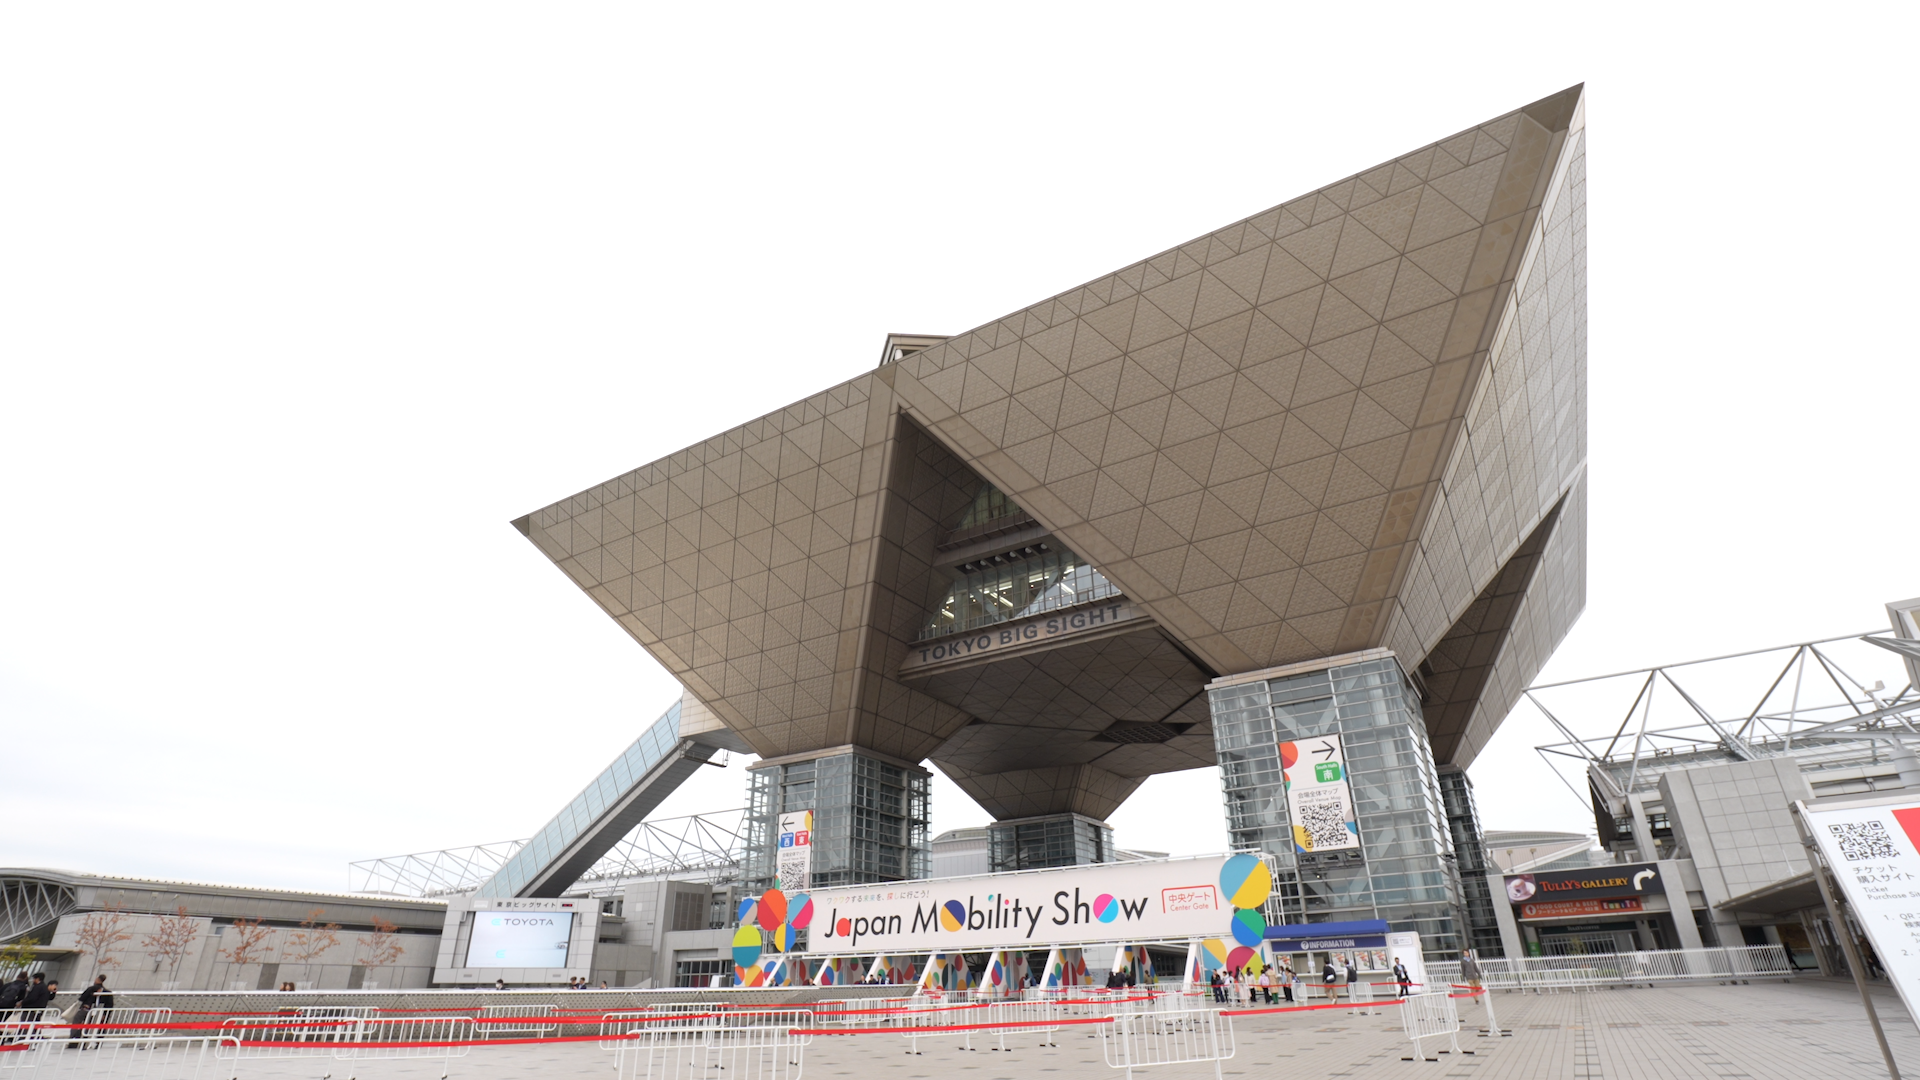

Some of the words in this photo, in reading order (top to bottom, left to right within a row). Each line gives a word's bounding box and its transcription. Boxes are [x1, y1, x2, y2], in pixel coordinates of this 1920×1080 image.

[918, 635, 991, 662] TOKYO
[1000, 624, 1038, 645] BIG
[1046, 604, 1122, 635] SIGHT
[1323, 769, 1334, 781] 南
[1853, 864, 1898, 874] チケット
[1581, 877, 1628, 889] GALLERY
[1856, 872, 1915, 884] 購入サイト
[1168, 891, 1211, 903] 中央ゲート
[1867, 892, 1907, 900] Purchase
[1193, 902, 1209, 910] Gate
[504, 918, 554, 926] TOYOTA
[824, 908, 902, 947] Japan
[1309, 939, 1355, 949] INFORMATION
